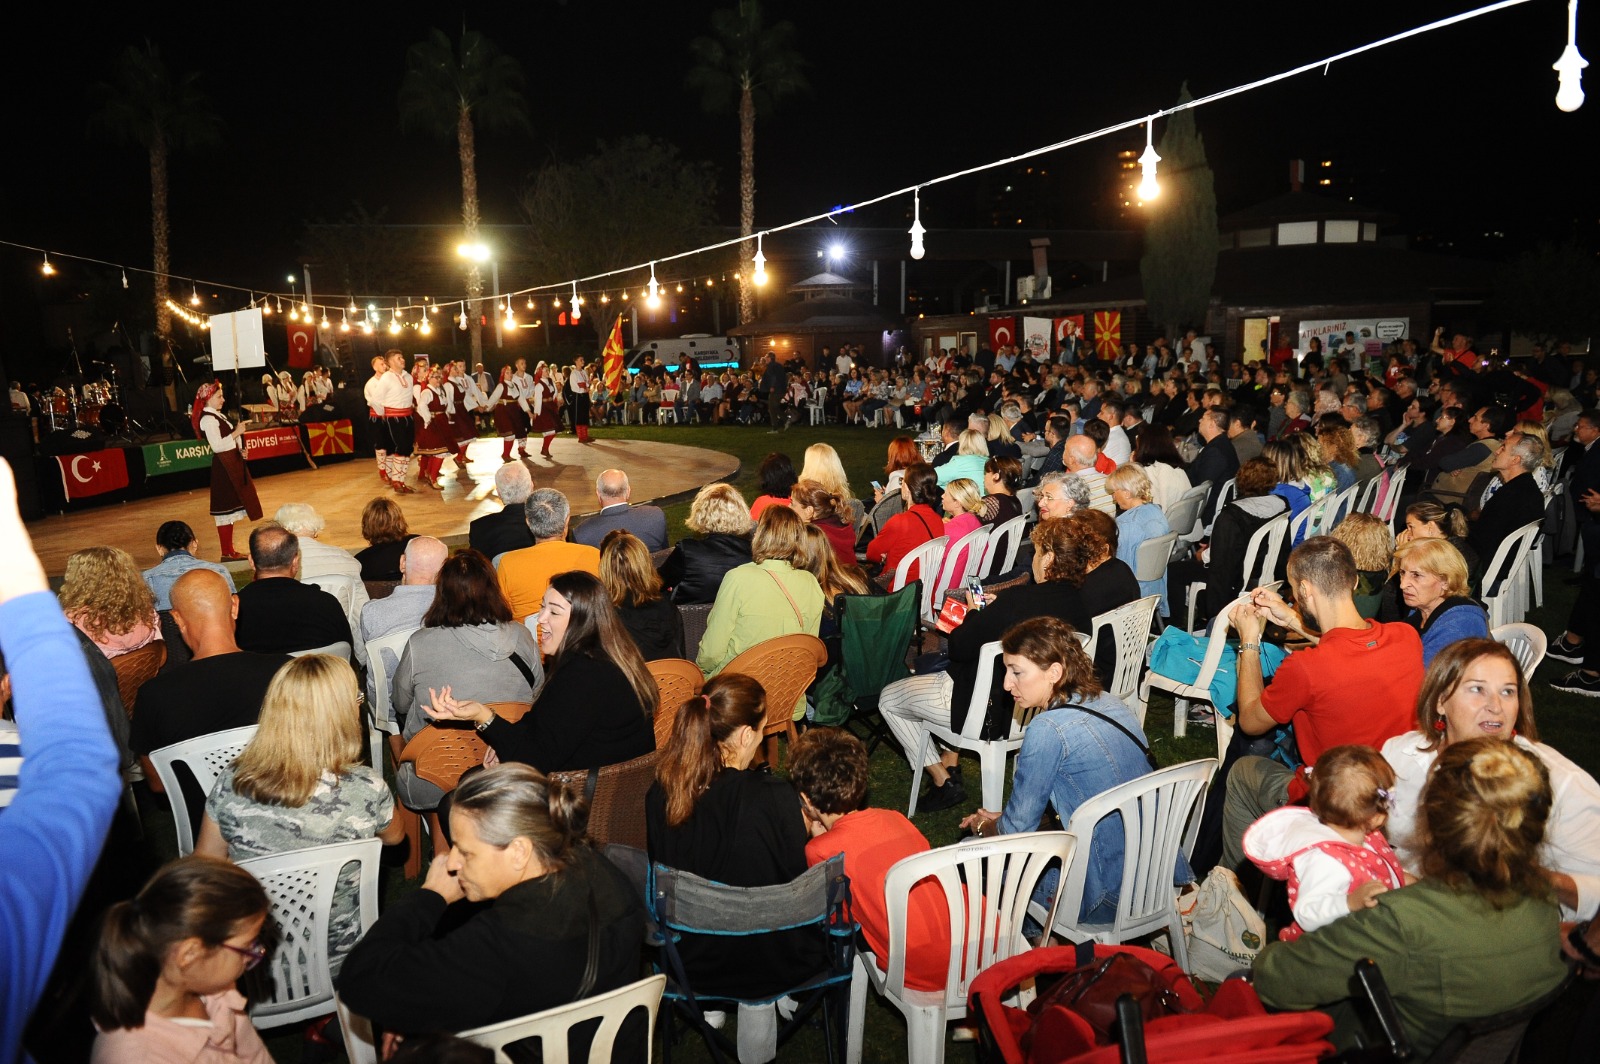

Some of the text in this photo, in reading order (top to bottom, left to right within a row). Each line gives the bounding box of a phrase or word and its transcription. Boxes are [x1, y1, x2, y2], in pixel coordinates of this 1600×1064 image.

[1302, 321, 1347, 339] ATIKLARINIZ
[175, 444, 212, 459] KARŞIY
[245, 433, 279, 449] EDİYESİ
